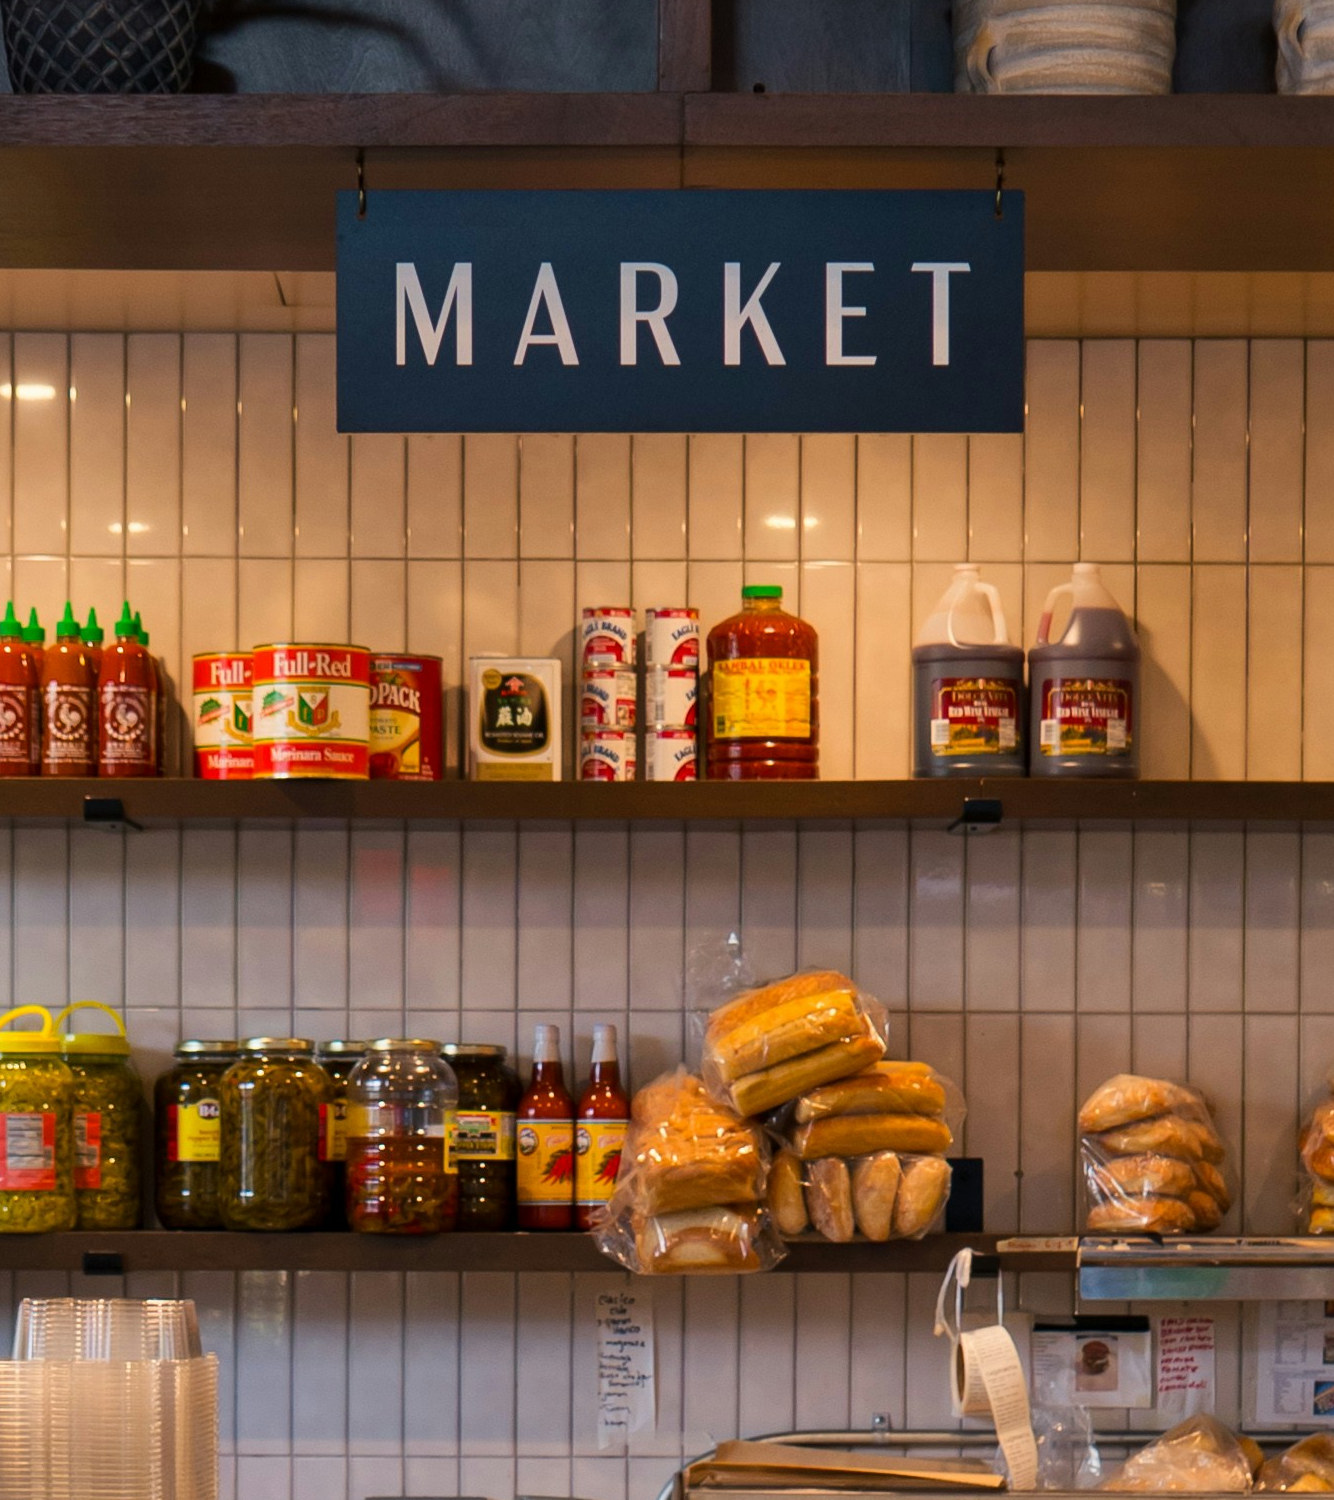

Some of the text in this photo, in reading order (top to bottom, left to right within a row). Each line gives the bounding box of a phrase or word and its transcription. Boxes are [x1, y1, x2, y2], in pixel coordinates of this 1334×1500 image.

[396, 262, 971, 365] MARKET
[602, 621, 627, 641] BRAND
[211, 661, 254, 685] Full-
[273, 653, 352, 678] Full-Red
[948, 706, 963, 717] RED
[964, 706, 983, 717] WINE
[1056, 707, 1071, 718] RED
[1072, 707, 1091, 718] WINE
[324, 749, 355, 764] Sauce
